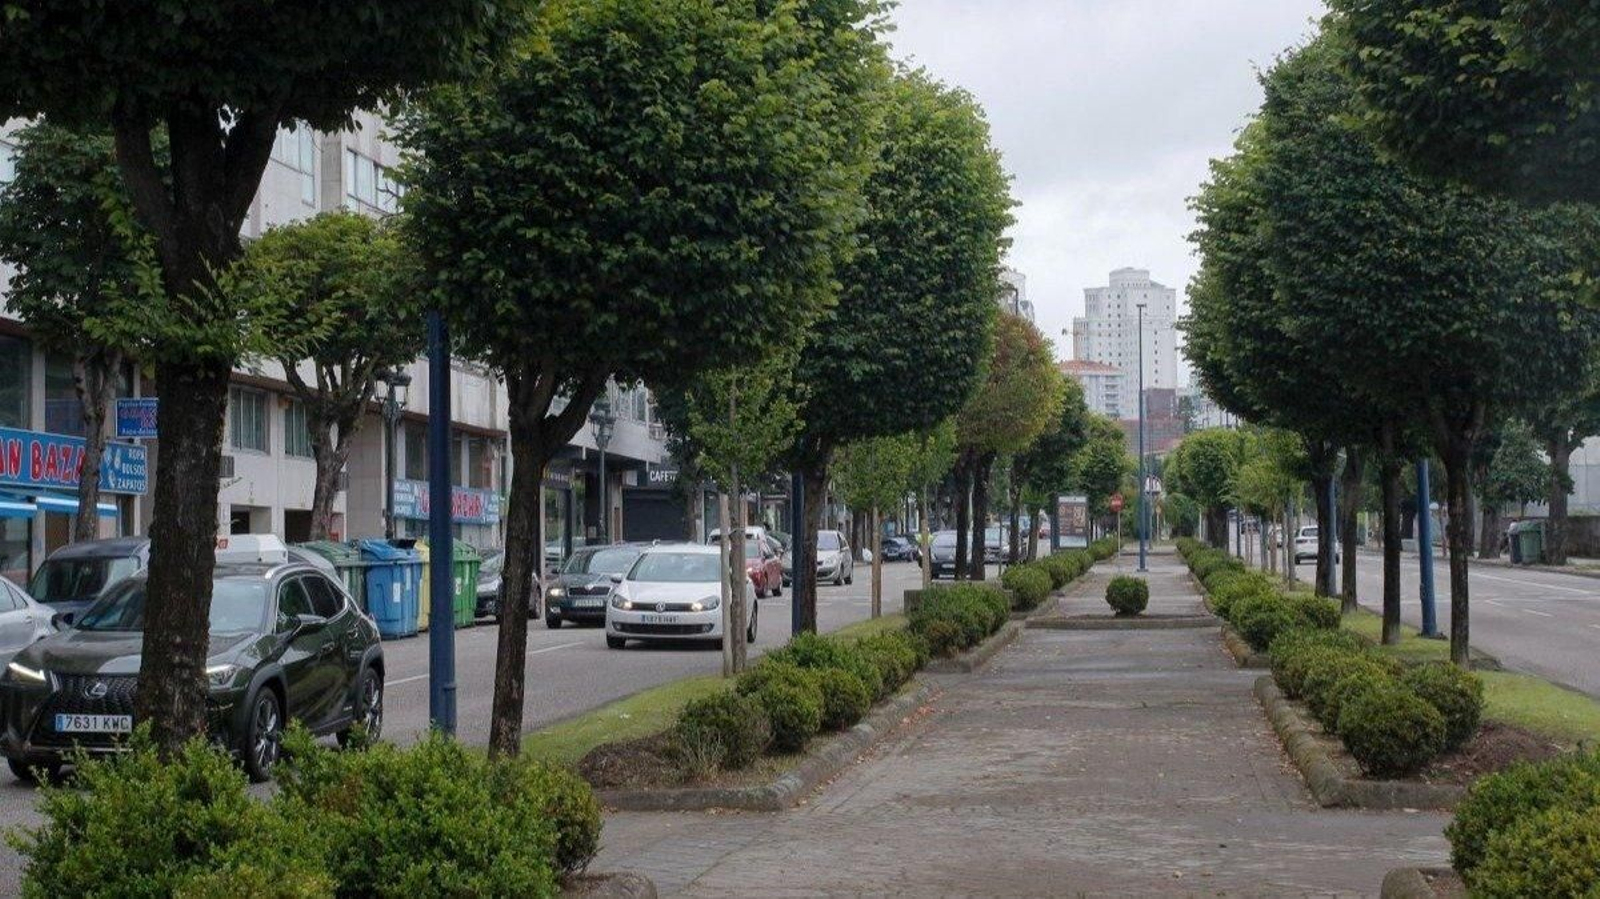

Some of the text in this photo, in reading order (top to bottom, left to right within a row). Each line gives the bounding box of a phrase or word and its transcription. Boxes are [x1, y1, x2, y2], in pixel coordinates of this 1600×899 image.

[128, 448, 145, 460] ROPA
[117, 478, 146, 492] ZAPATOS
[65, 715, 129, 731] 7631 KWC
